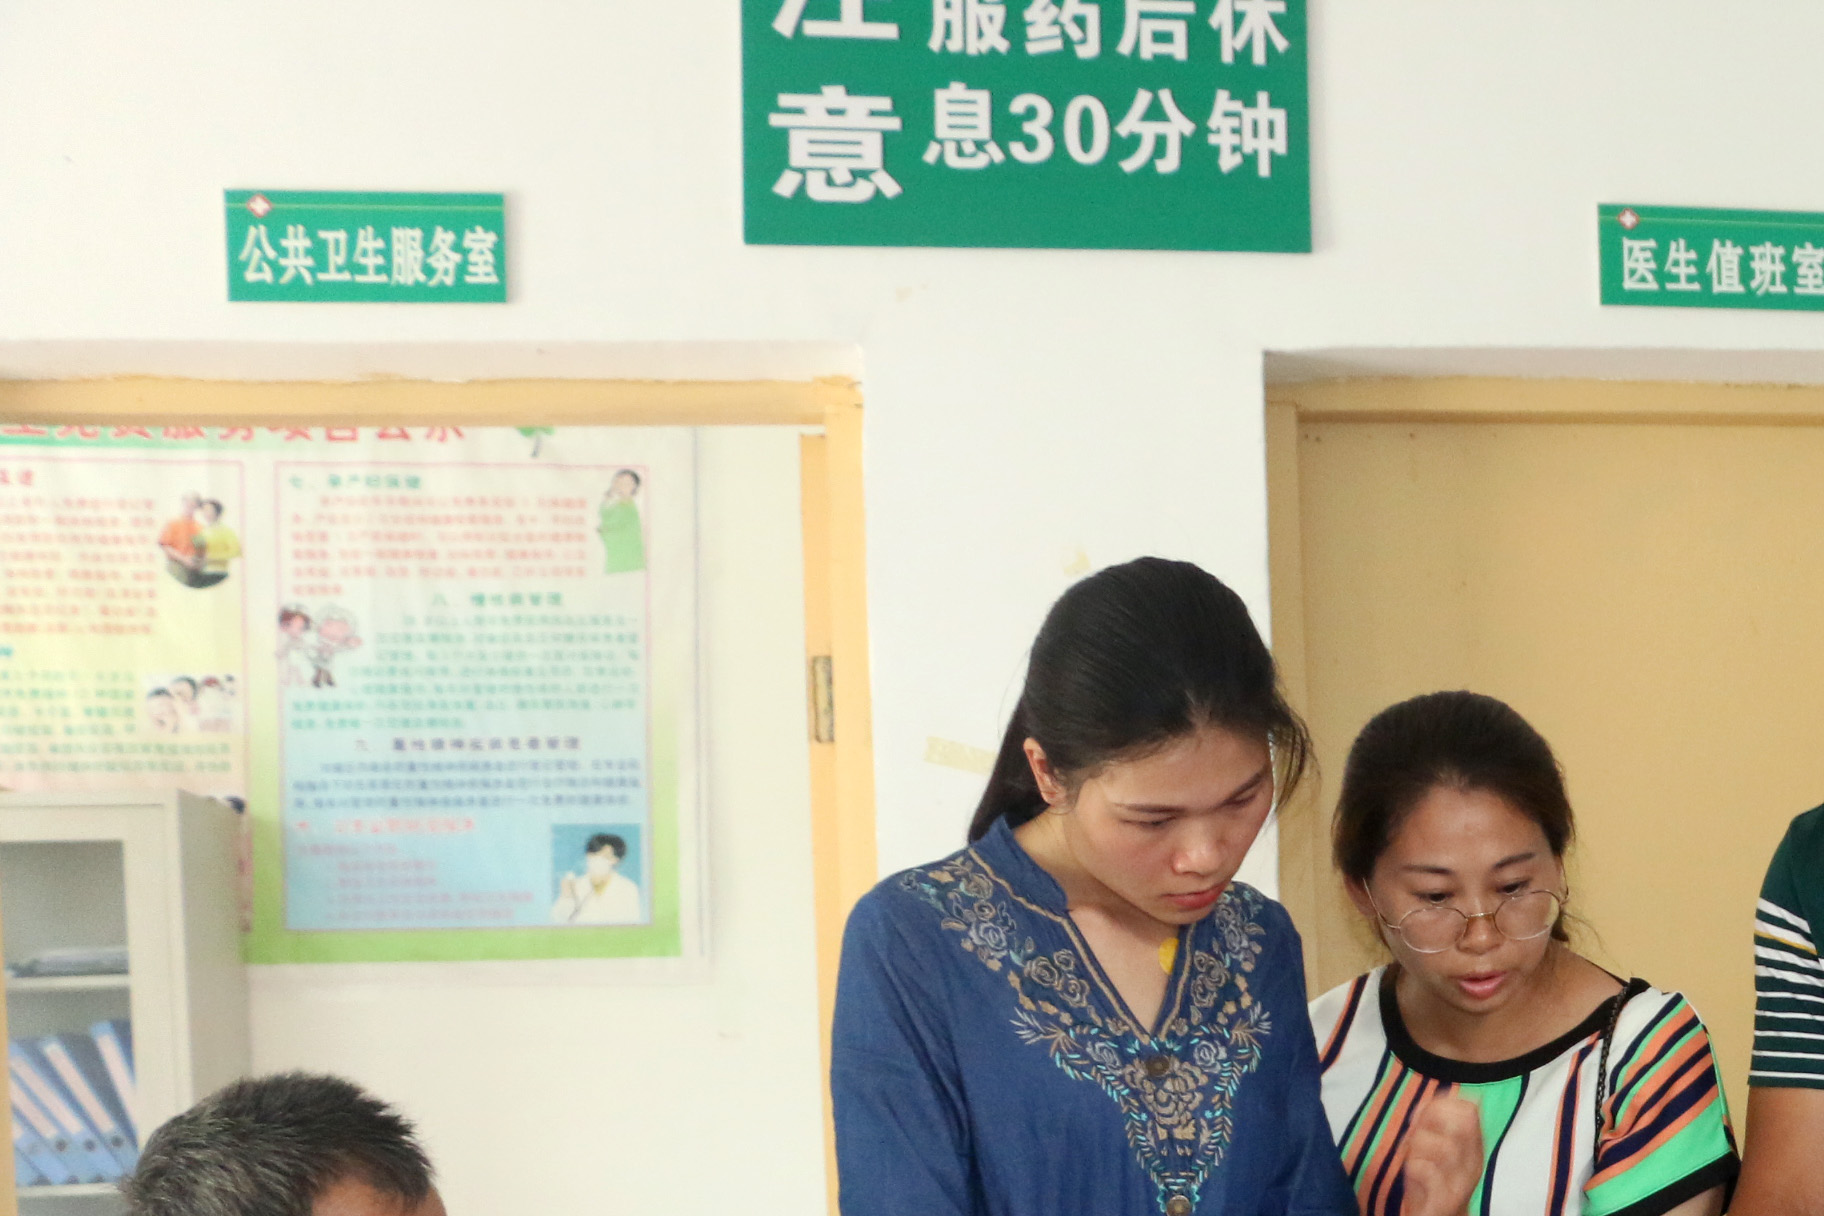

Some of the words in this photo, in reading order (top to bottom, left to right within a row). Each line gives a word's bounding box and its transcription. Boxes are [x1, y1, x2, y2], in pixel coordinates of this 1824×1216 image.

[922, 81, 1289, 178] 息30分钟
[238, 223, 500, 287] 公共卫生服务室
